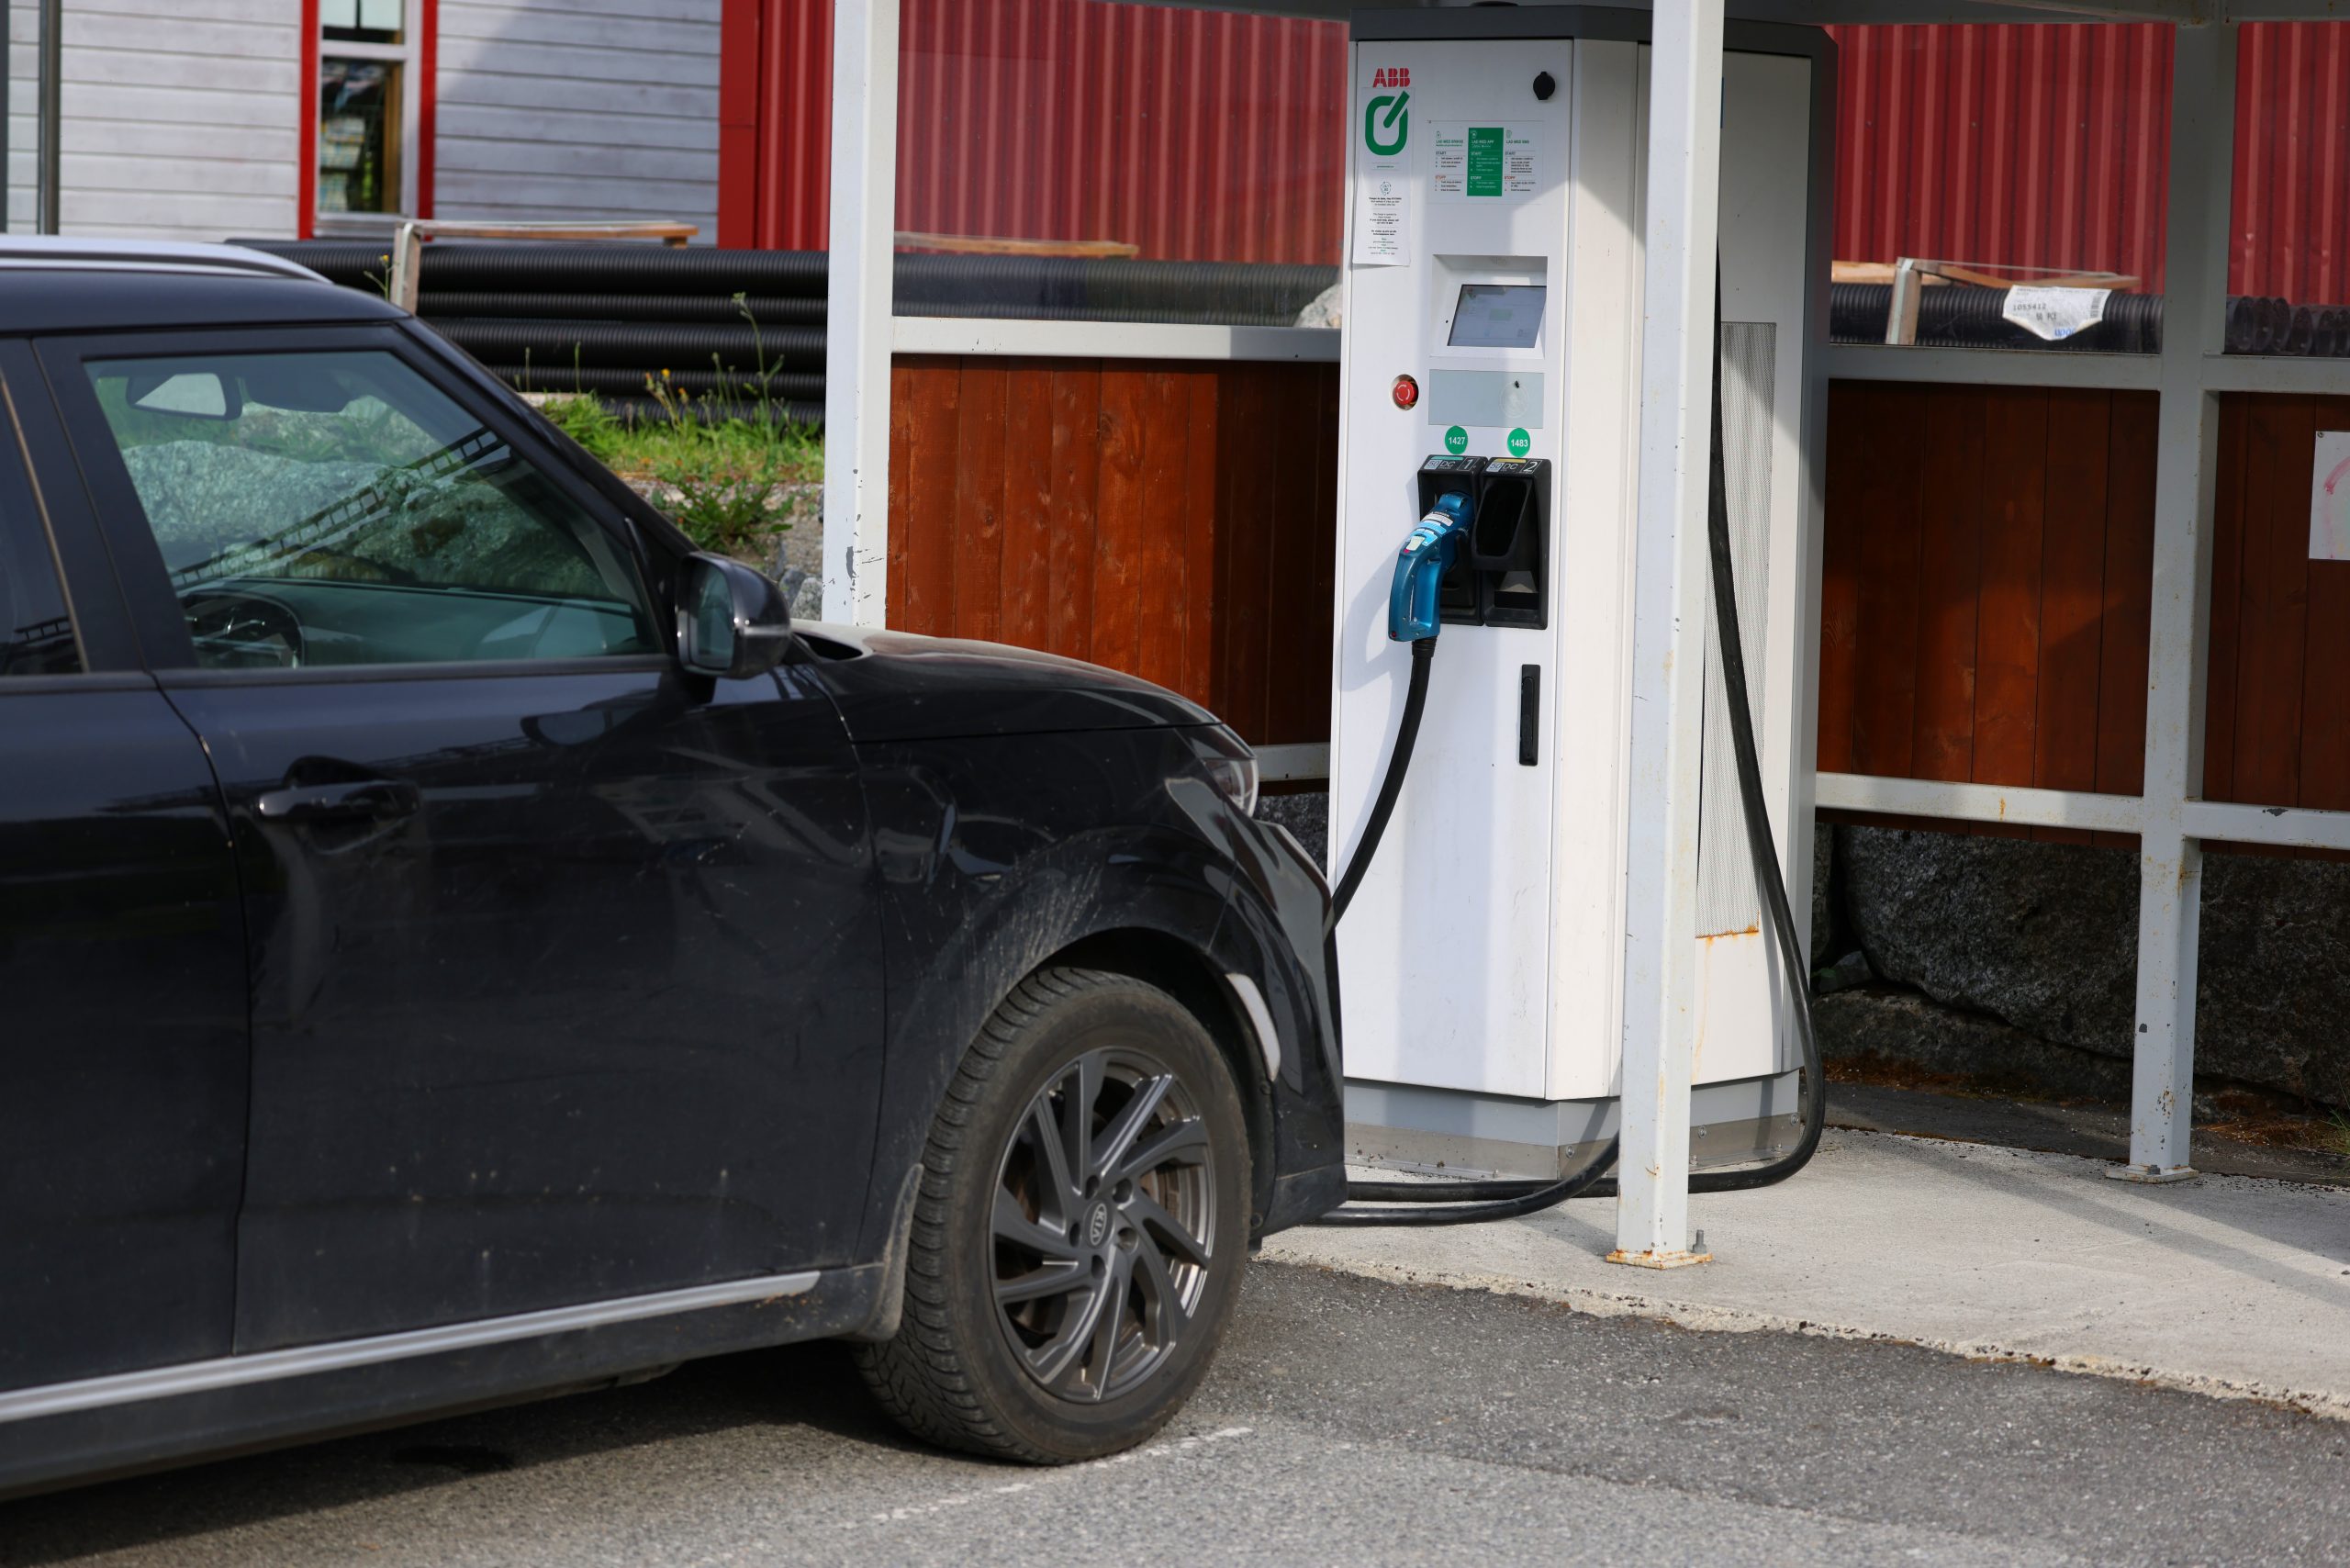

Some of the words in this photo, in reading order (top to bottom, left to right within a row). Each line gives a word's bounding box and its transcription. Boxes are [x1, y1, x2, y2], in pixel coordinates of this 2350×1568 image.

[1372, 67, 1411, 88] ABB
[1448, 436, 1465, 445] 1427
[1510, 439, 1528, 447] 1483
[1464, 459, 1472, 470] 1
[1523, 461, 1539, 472] 2
[1091, 1211, 1105, 1238] KIA
